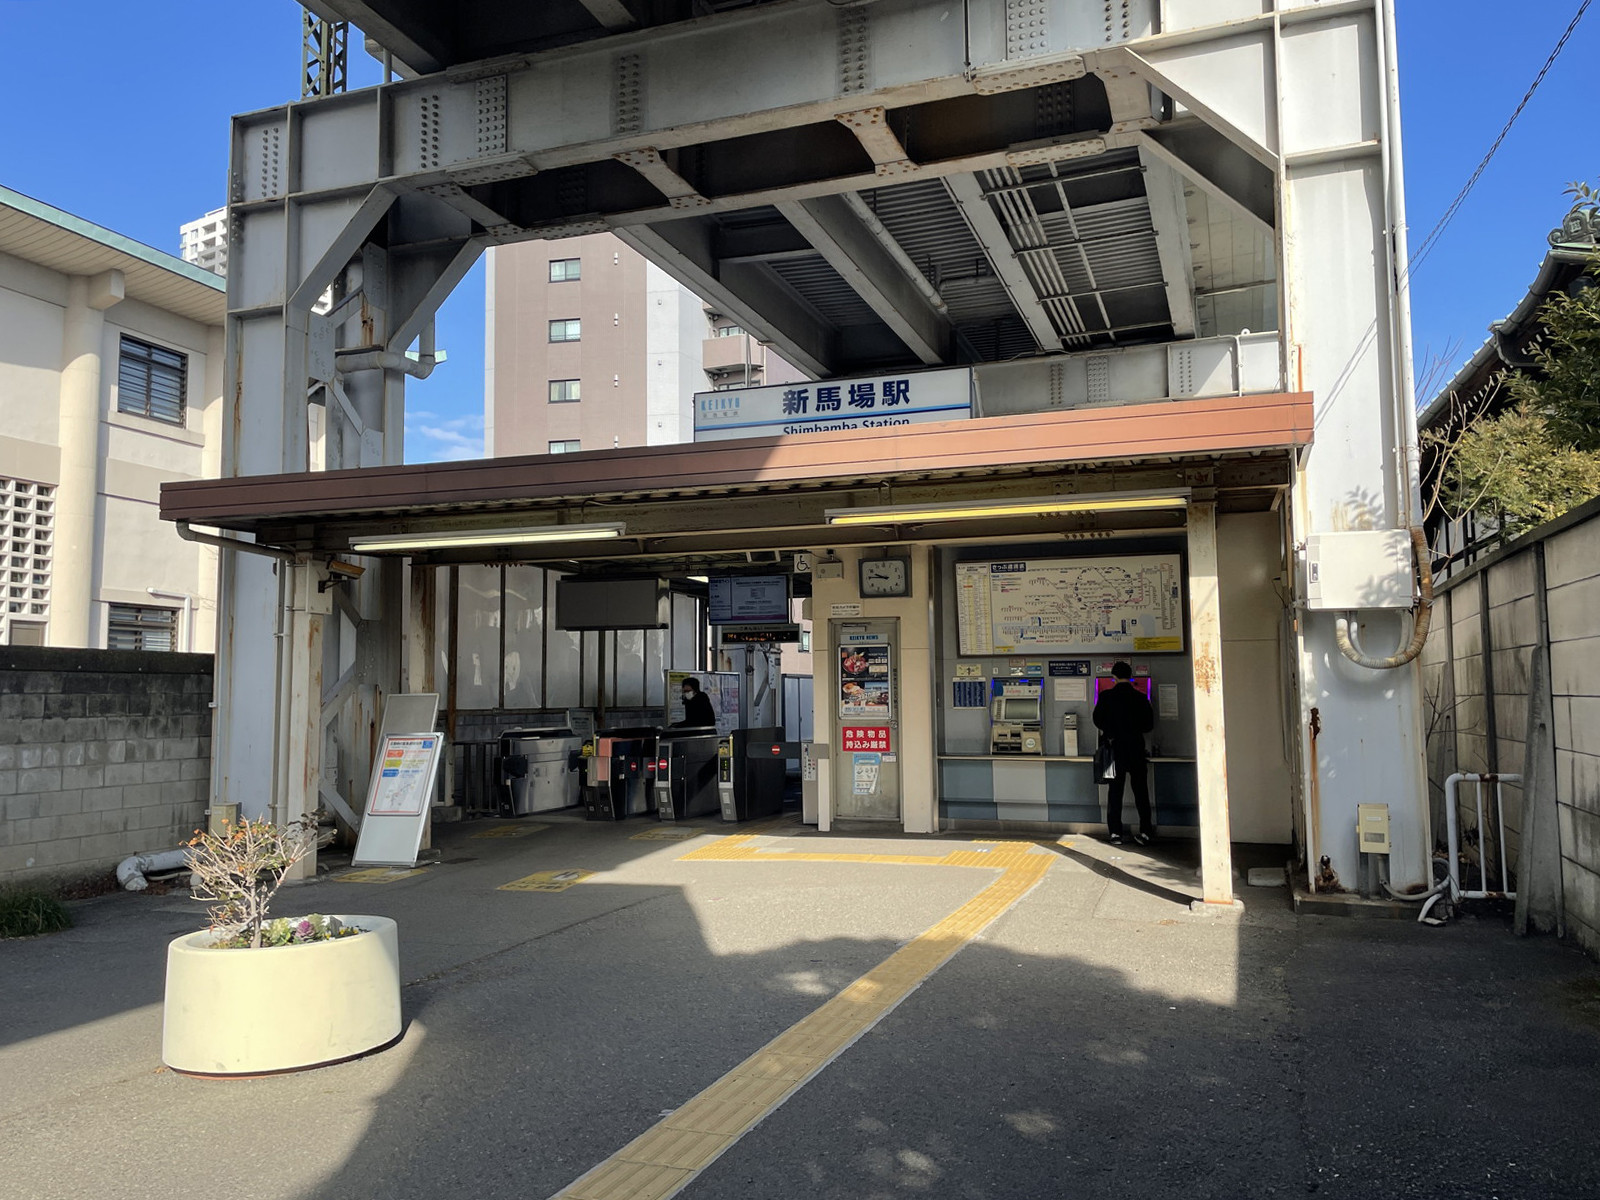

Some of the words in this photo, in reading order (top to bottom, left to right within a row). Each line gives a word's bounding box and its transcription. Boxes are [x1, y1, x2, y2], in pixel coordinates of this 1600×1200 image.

[701, 397, 740, 411] KEIKYU
[783, 379, 910, 415] 新馬場駅
[783, 421, 858, 435] Shimbamba
[862, 418, 910, 429] Station
[845, 729, 887, 739] 危険物品
[845, 740, 887, 749] 持込み厳禁
